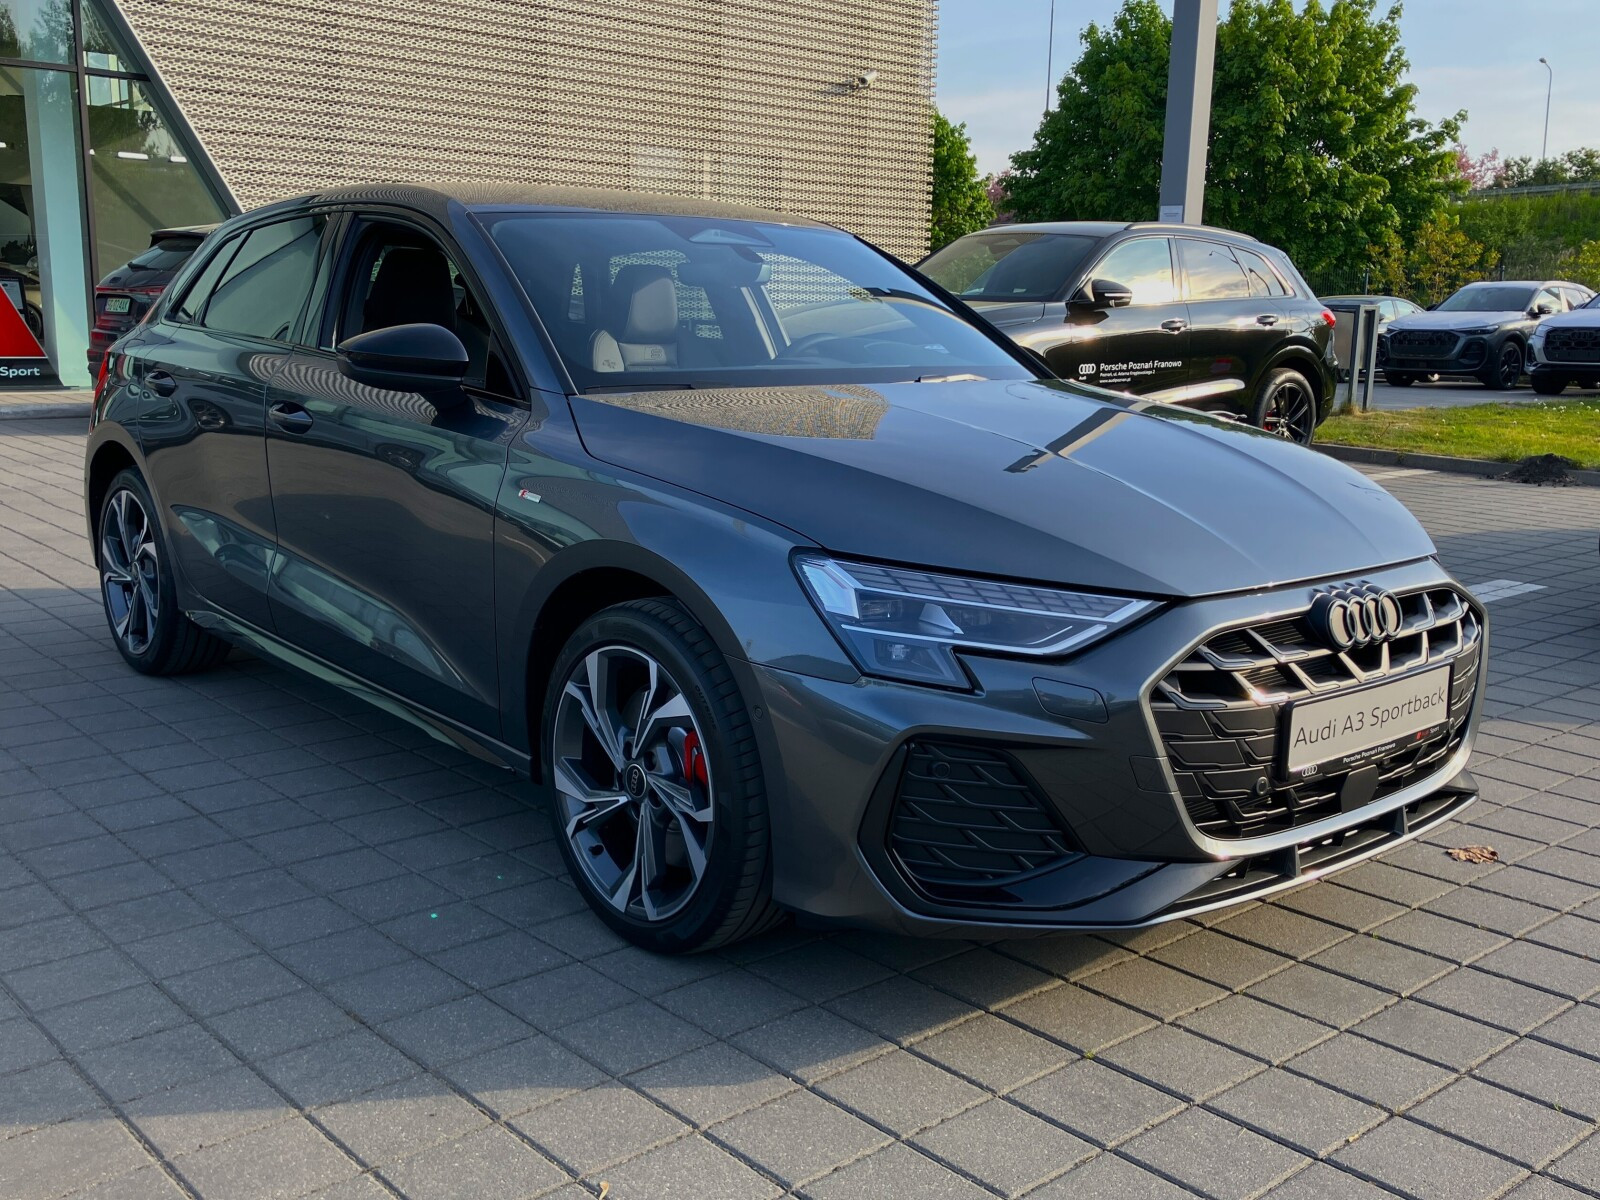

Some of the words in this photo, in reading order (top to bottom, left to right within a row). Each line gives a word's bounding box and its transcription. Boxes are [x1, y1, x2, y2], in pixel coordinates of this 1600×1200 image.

[0, 366, 41, 378] Sport
[1100, 362, 1127, 372] Porsche
[1128, 360, 1153, 370] Poznań
[1154, 360, 1182, 368] Franowo
[1293, 718, 1337, 748] Audi
[1341, 711, 1365, 736] A3
[1369, 686, 1445, 729] Sportback
[1343, 752, 1361, 764] Porsche
[1377, 743, 1396, 753] Franowo
